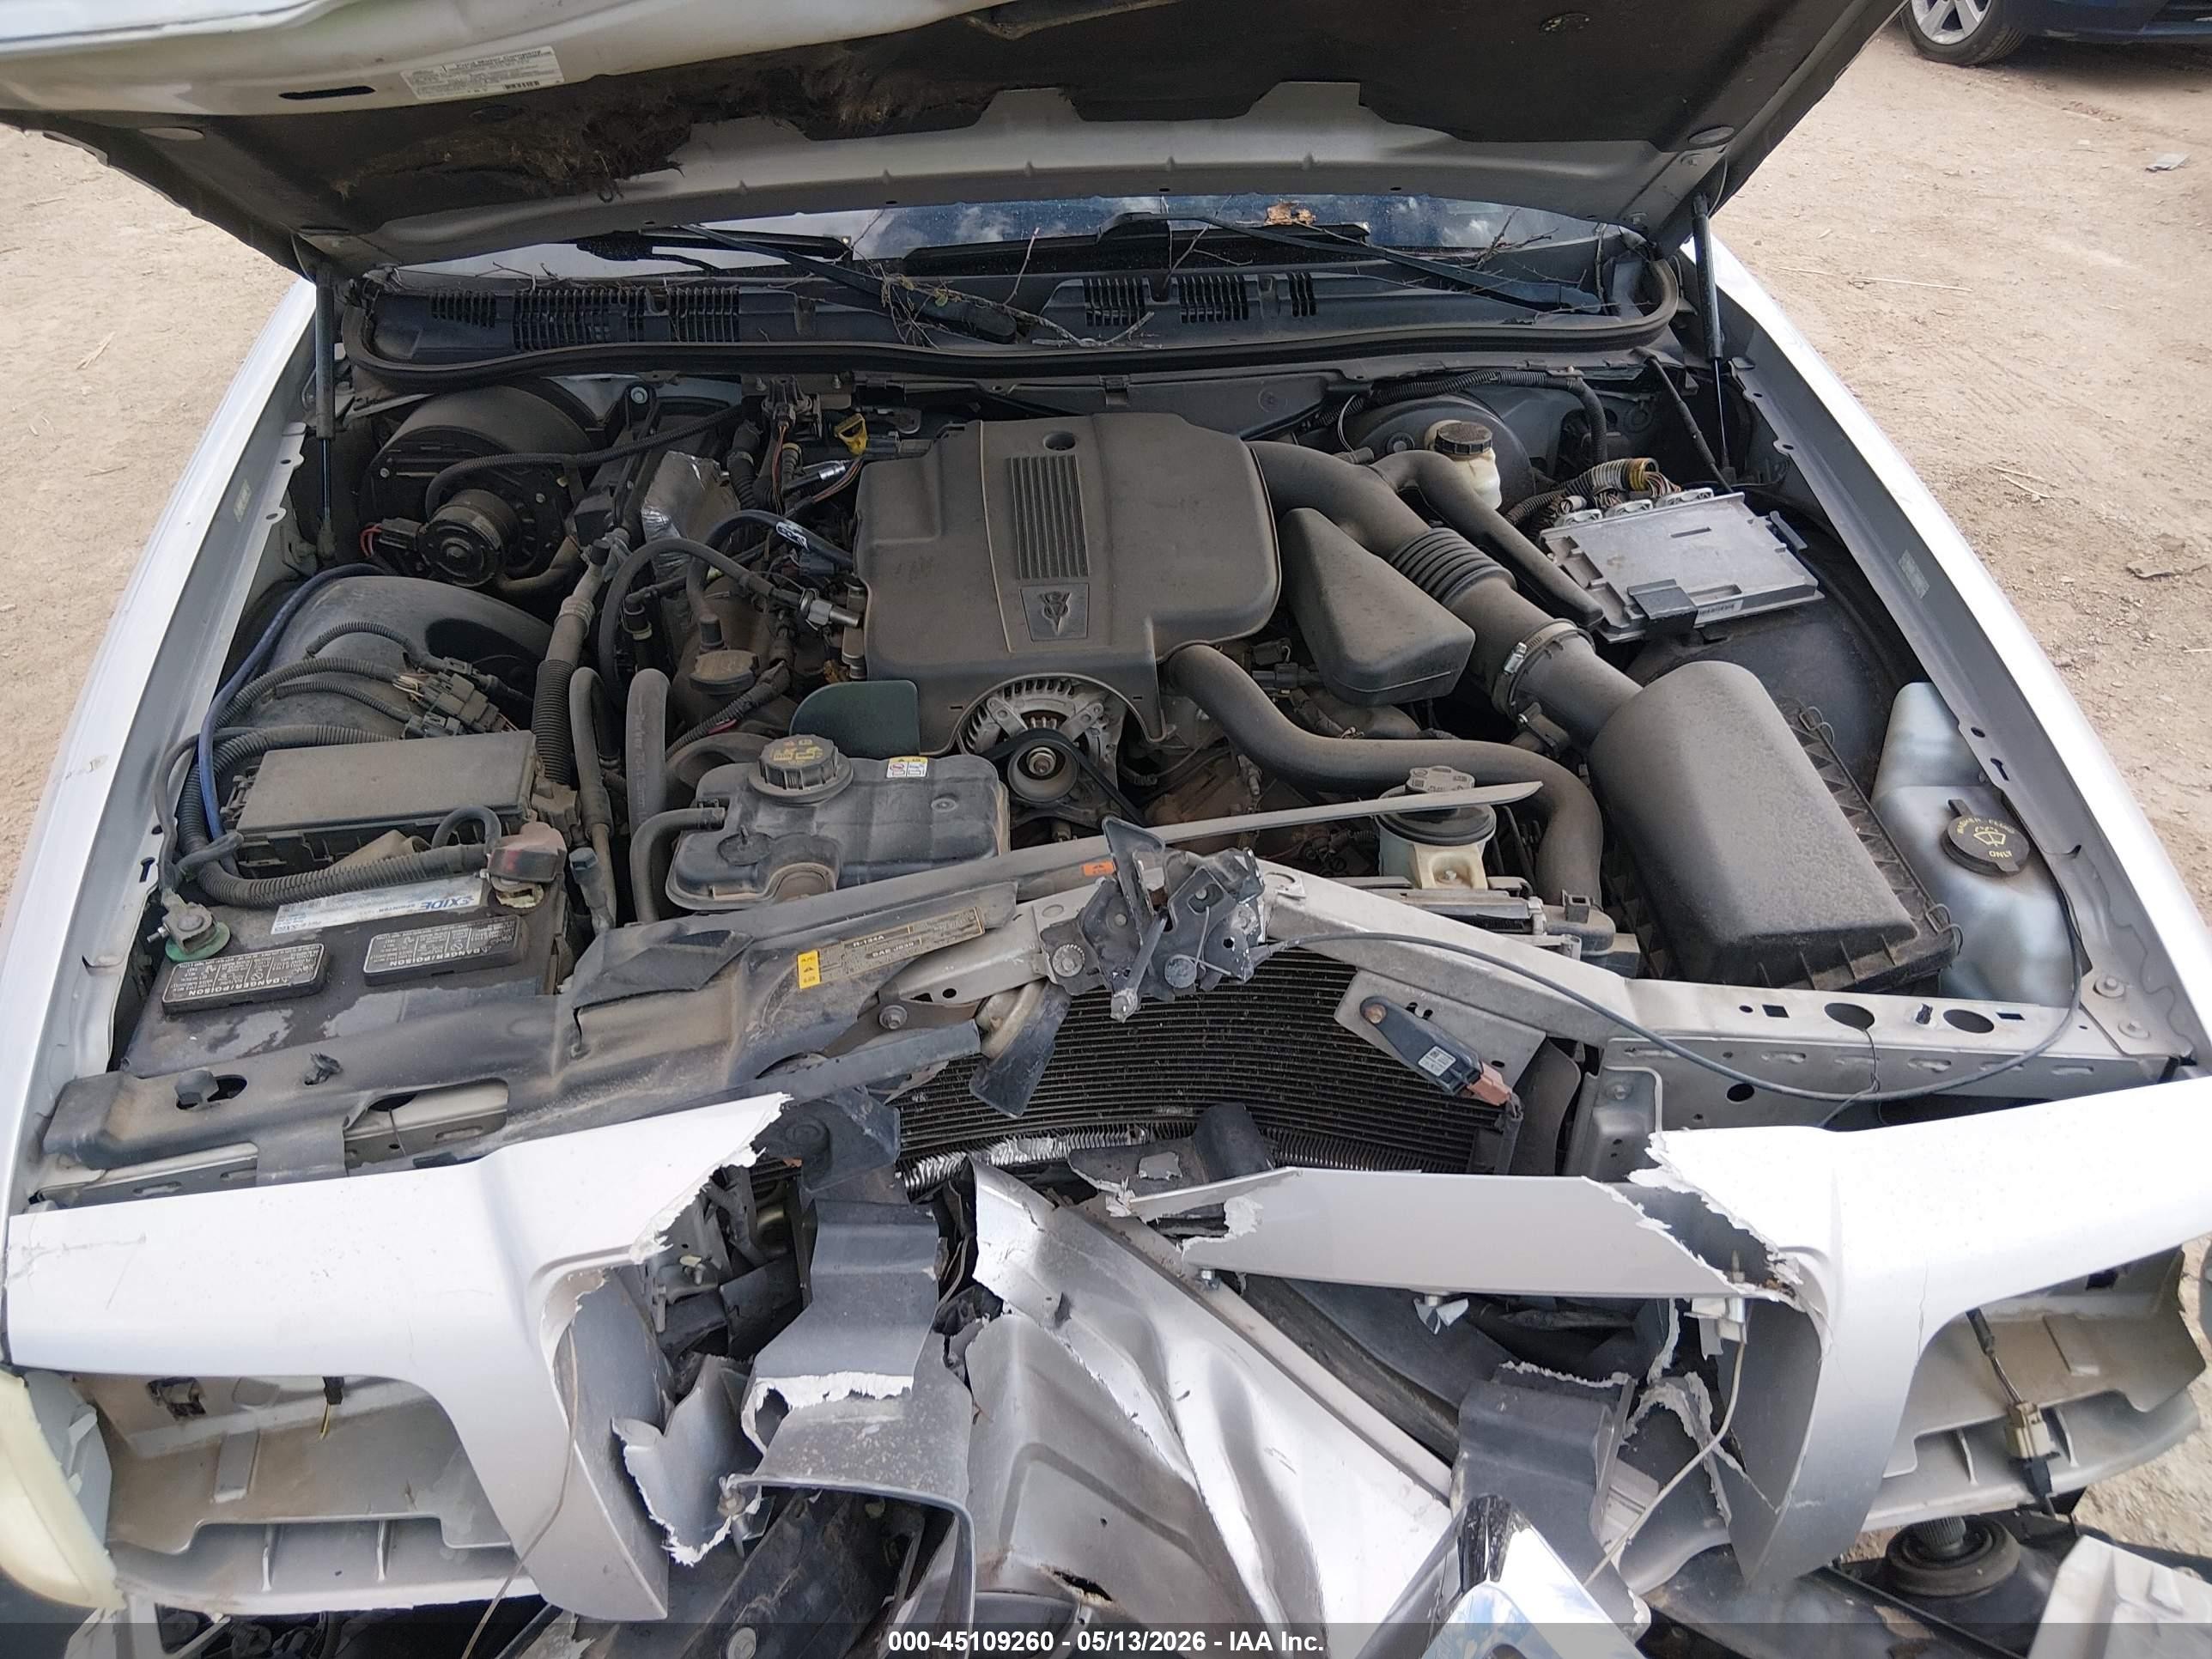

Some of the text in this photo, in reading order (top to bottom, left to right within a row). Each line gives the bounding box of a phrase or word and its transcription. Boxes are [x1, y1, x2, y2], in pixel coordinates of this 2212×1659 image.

[1988, 849, 2013, 859] ONLY
[420, 896, 475, 912] EXIDE
[389, 948, 481, 967] DANGER/POISON
[187, 977, 280, 997] DANGER/POISON
